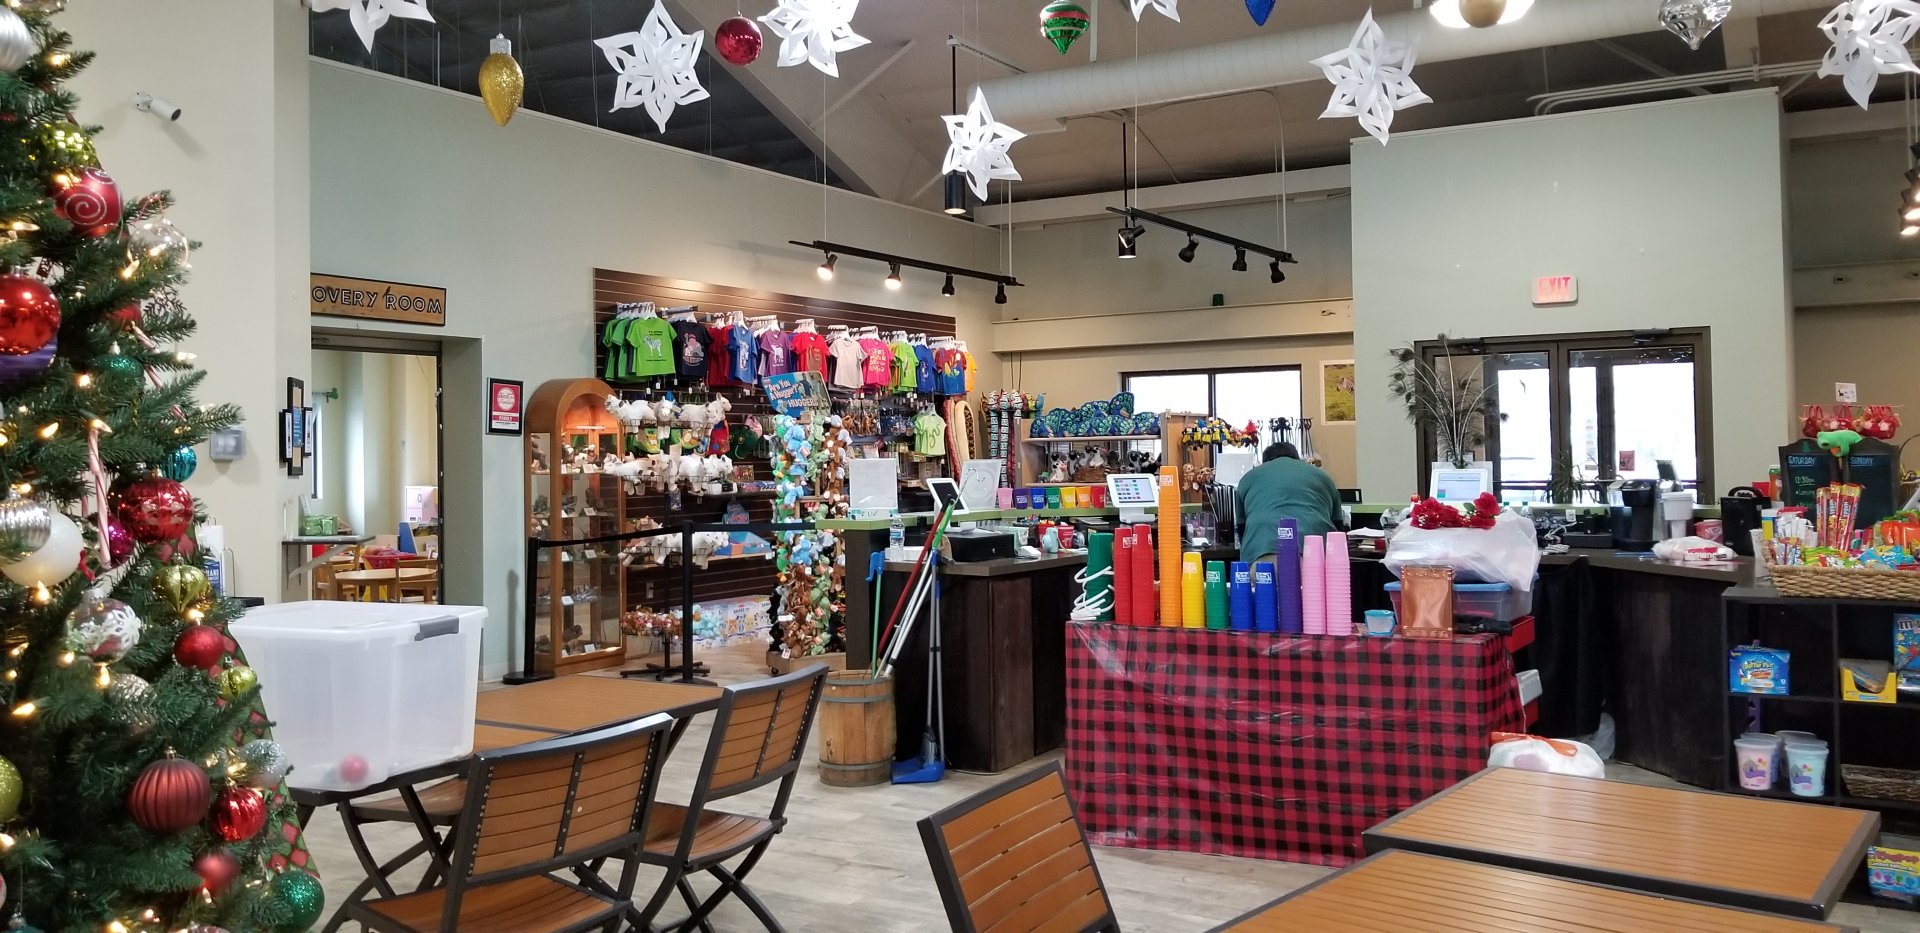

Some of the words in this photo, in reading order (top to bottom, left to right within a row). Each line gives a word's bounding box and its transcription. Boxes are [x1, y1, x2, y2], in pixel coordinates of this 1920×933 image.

[1538, 276, 1571, 299] EXIT
[311, 286, 379, 307] OVERY
[385, 293, 443, 314] ROOM
[1787, 455, 1816, 465] SATURDAY
[1850, 456, 1874, 465] SUNDAY
